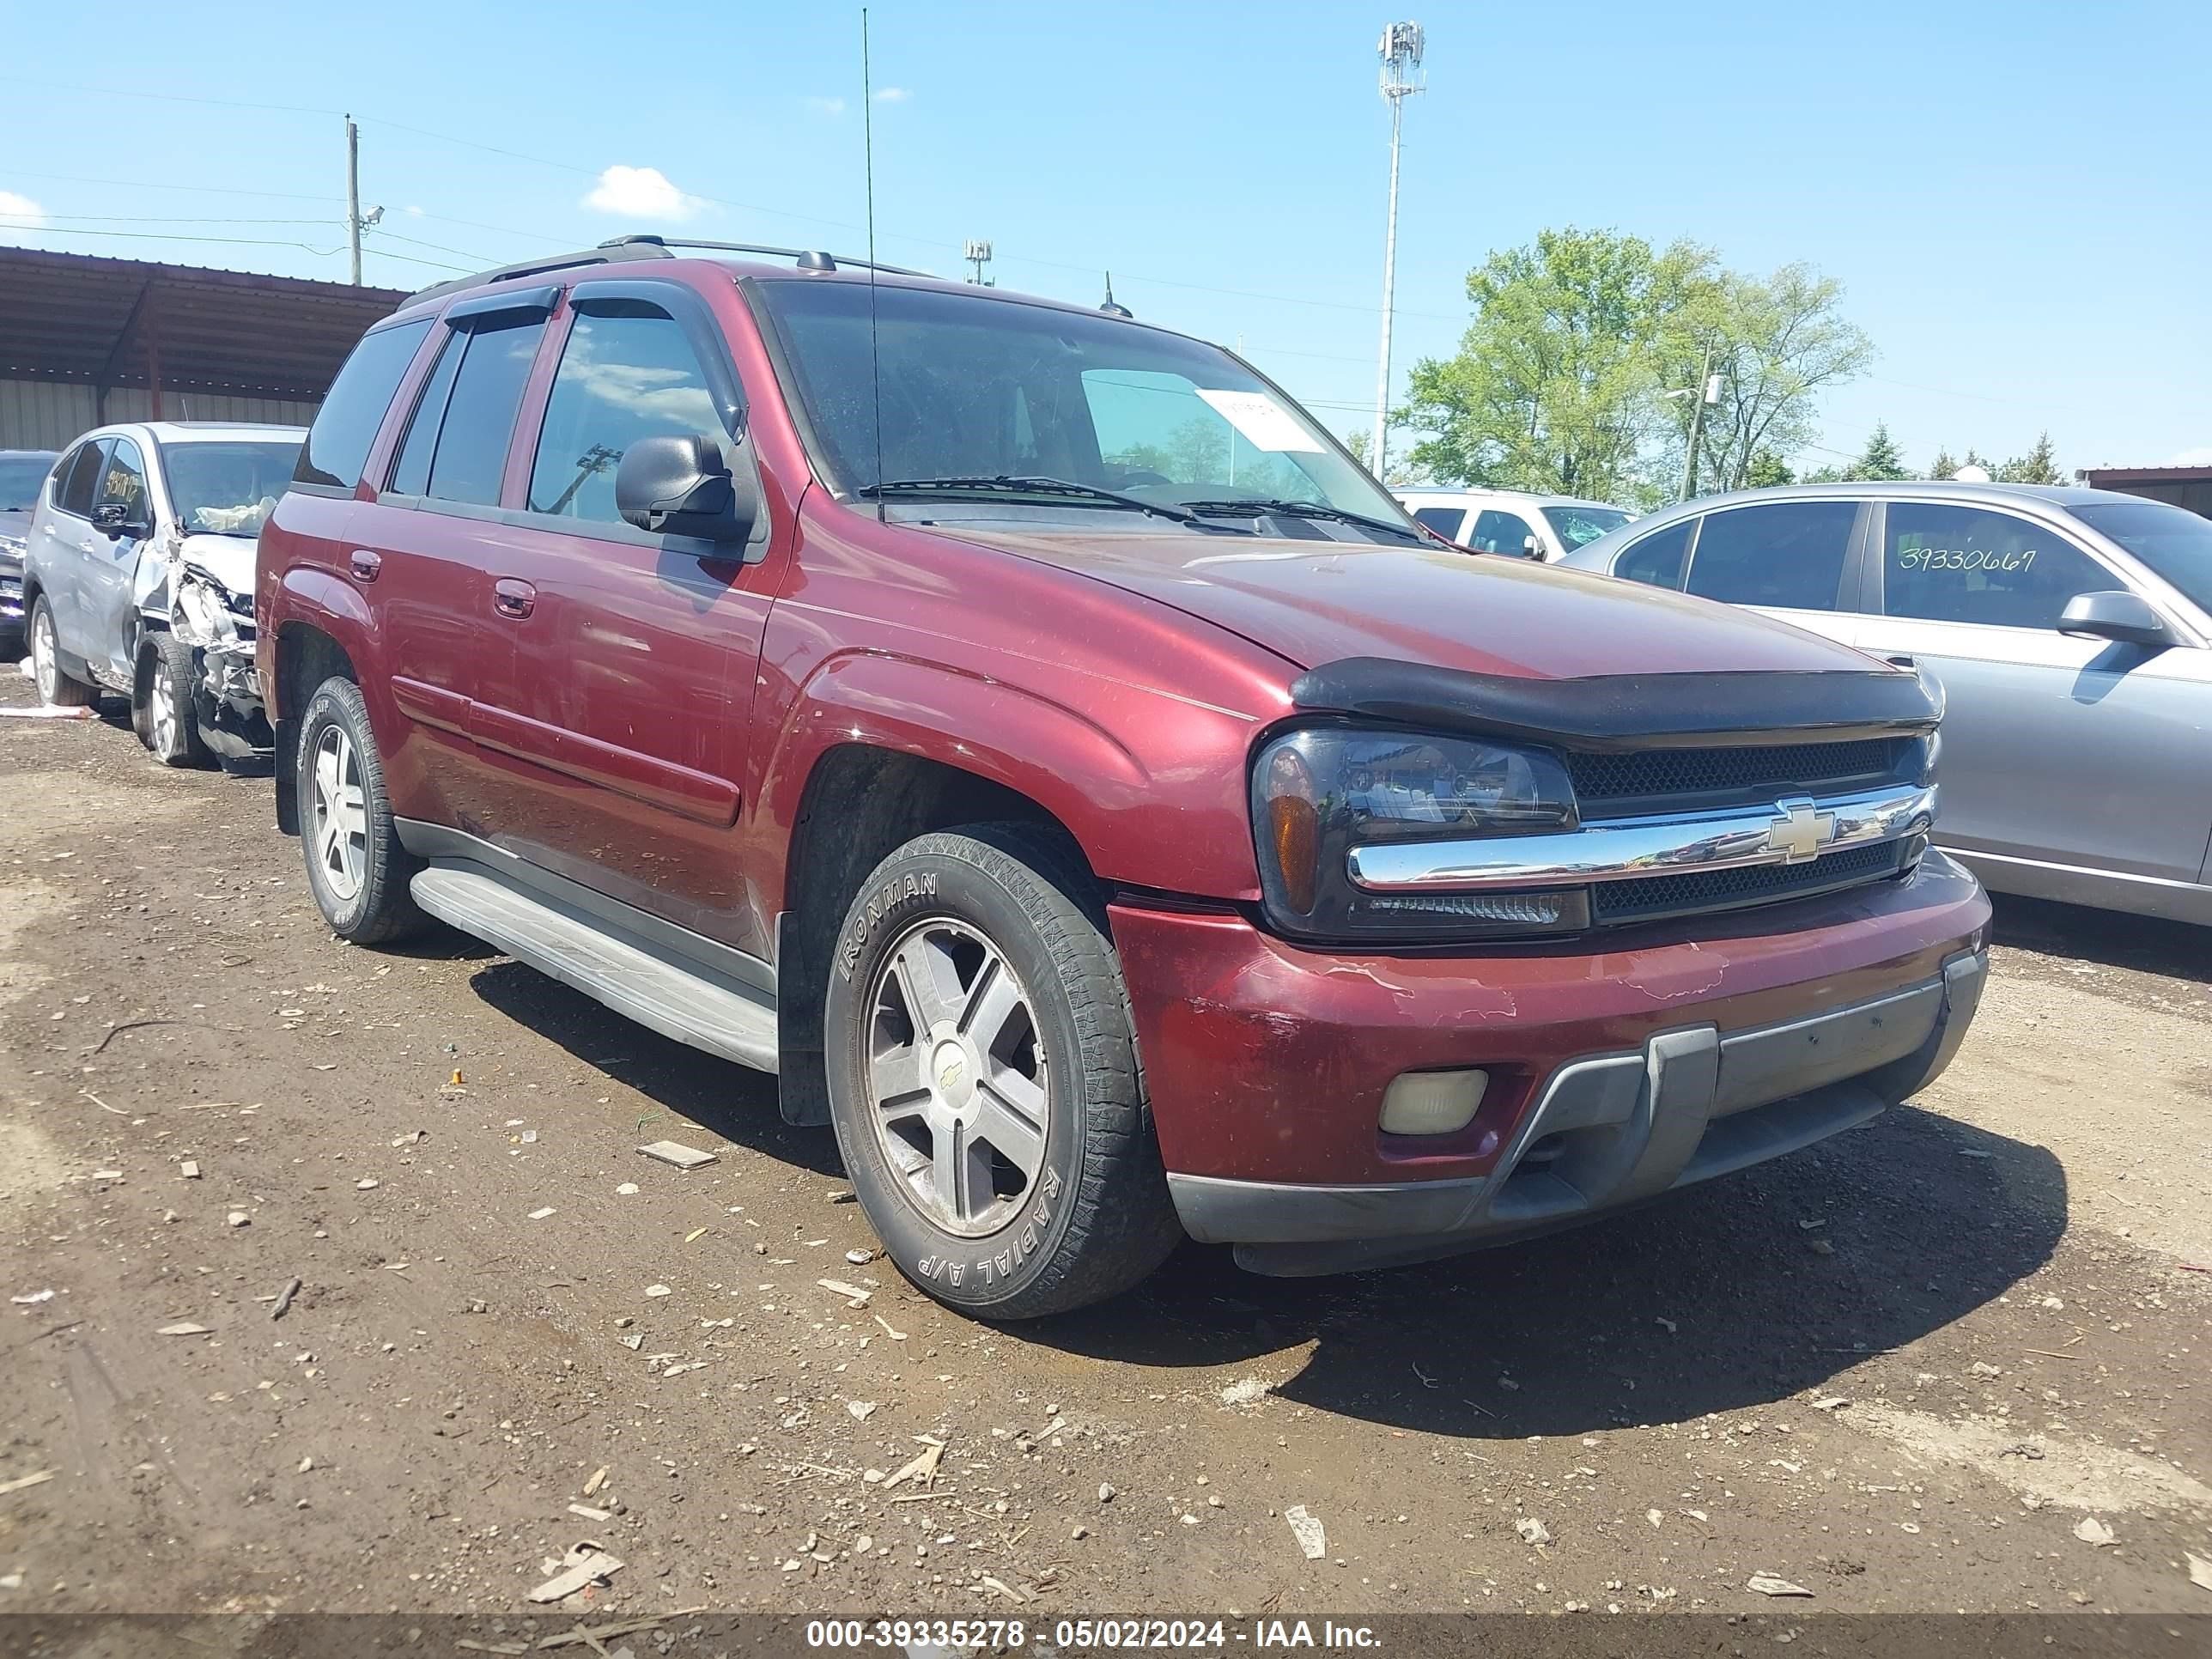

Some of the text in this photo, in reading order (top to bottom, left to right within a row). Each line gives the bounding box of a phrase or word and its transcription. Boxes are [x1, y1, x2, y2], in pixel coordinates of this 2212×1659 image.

[1899, 548, 2037, 573] 39330667
[838, 872, 939, 983] IRONMAN
[976, 1165, 1063, 1285] RADIAL
[918, 1255, 966, 1288] A/P
